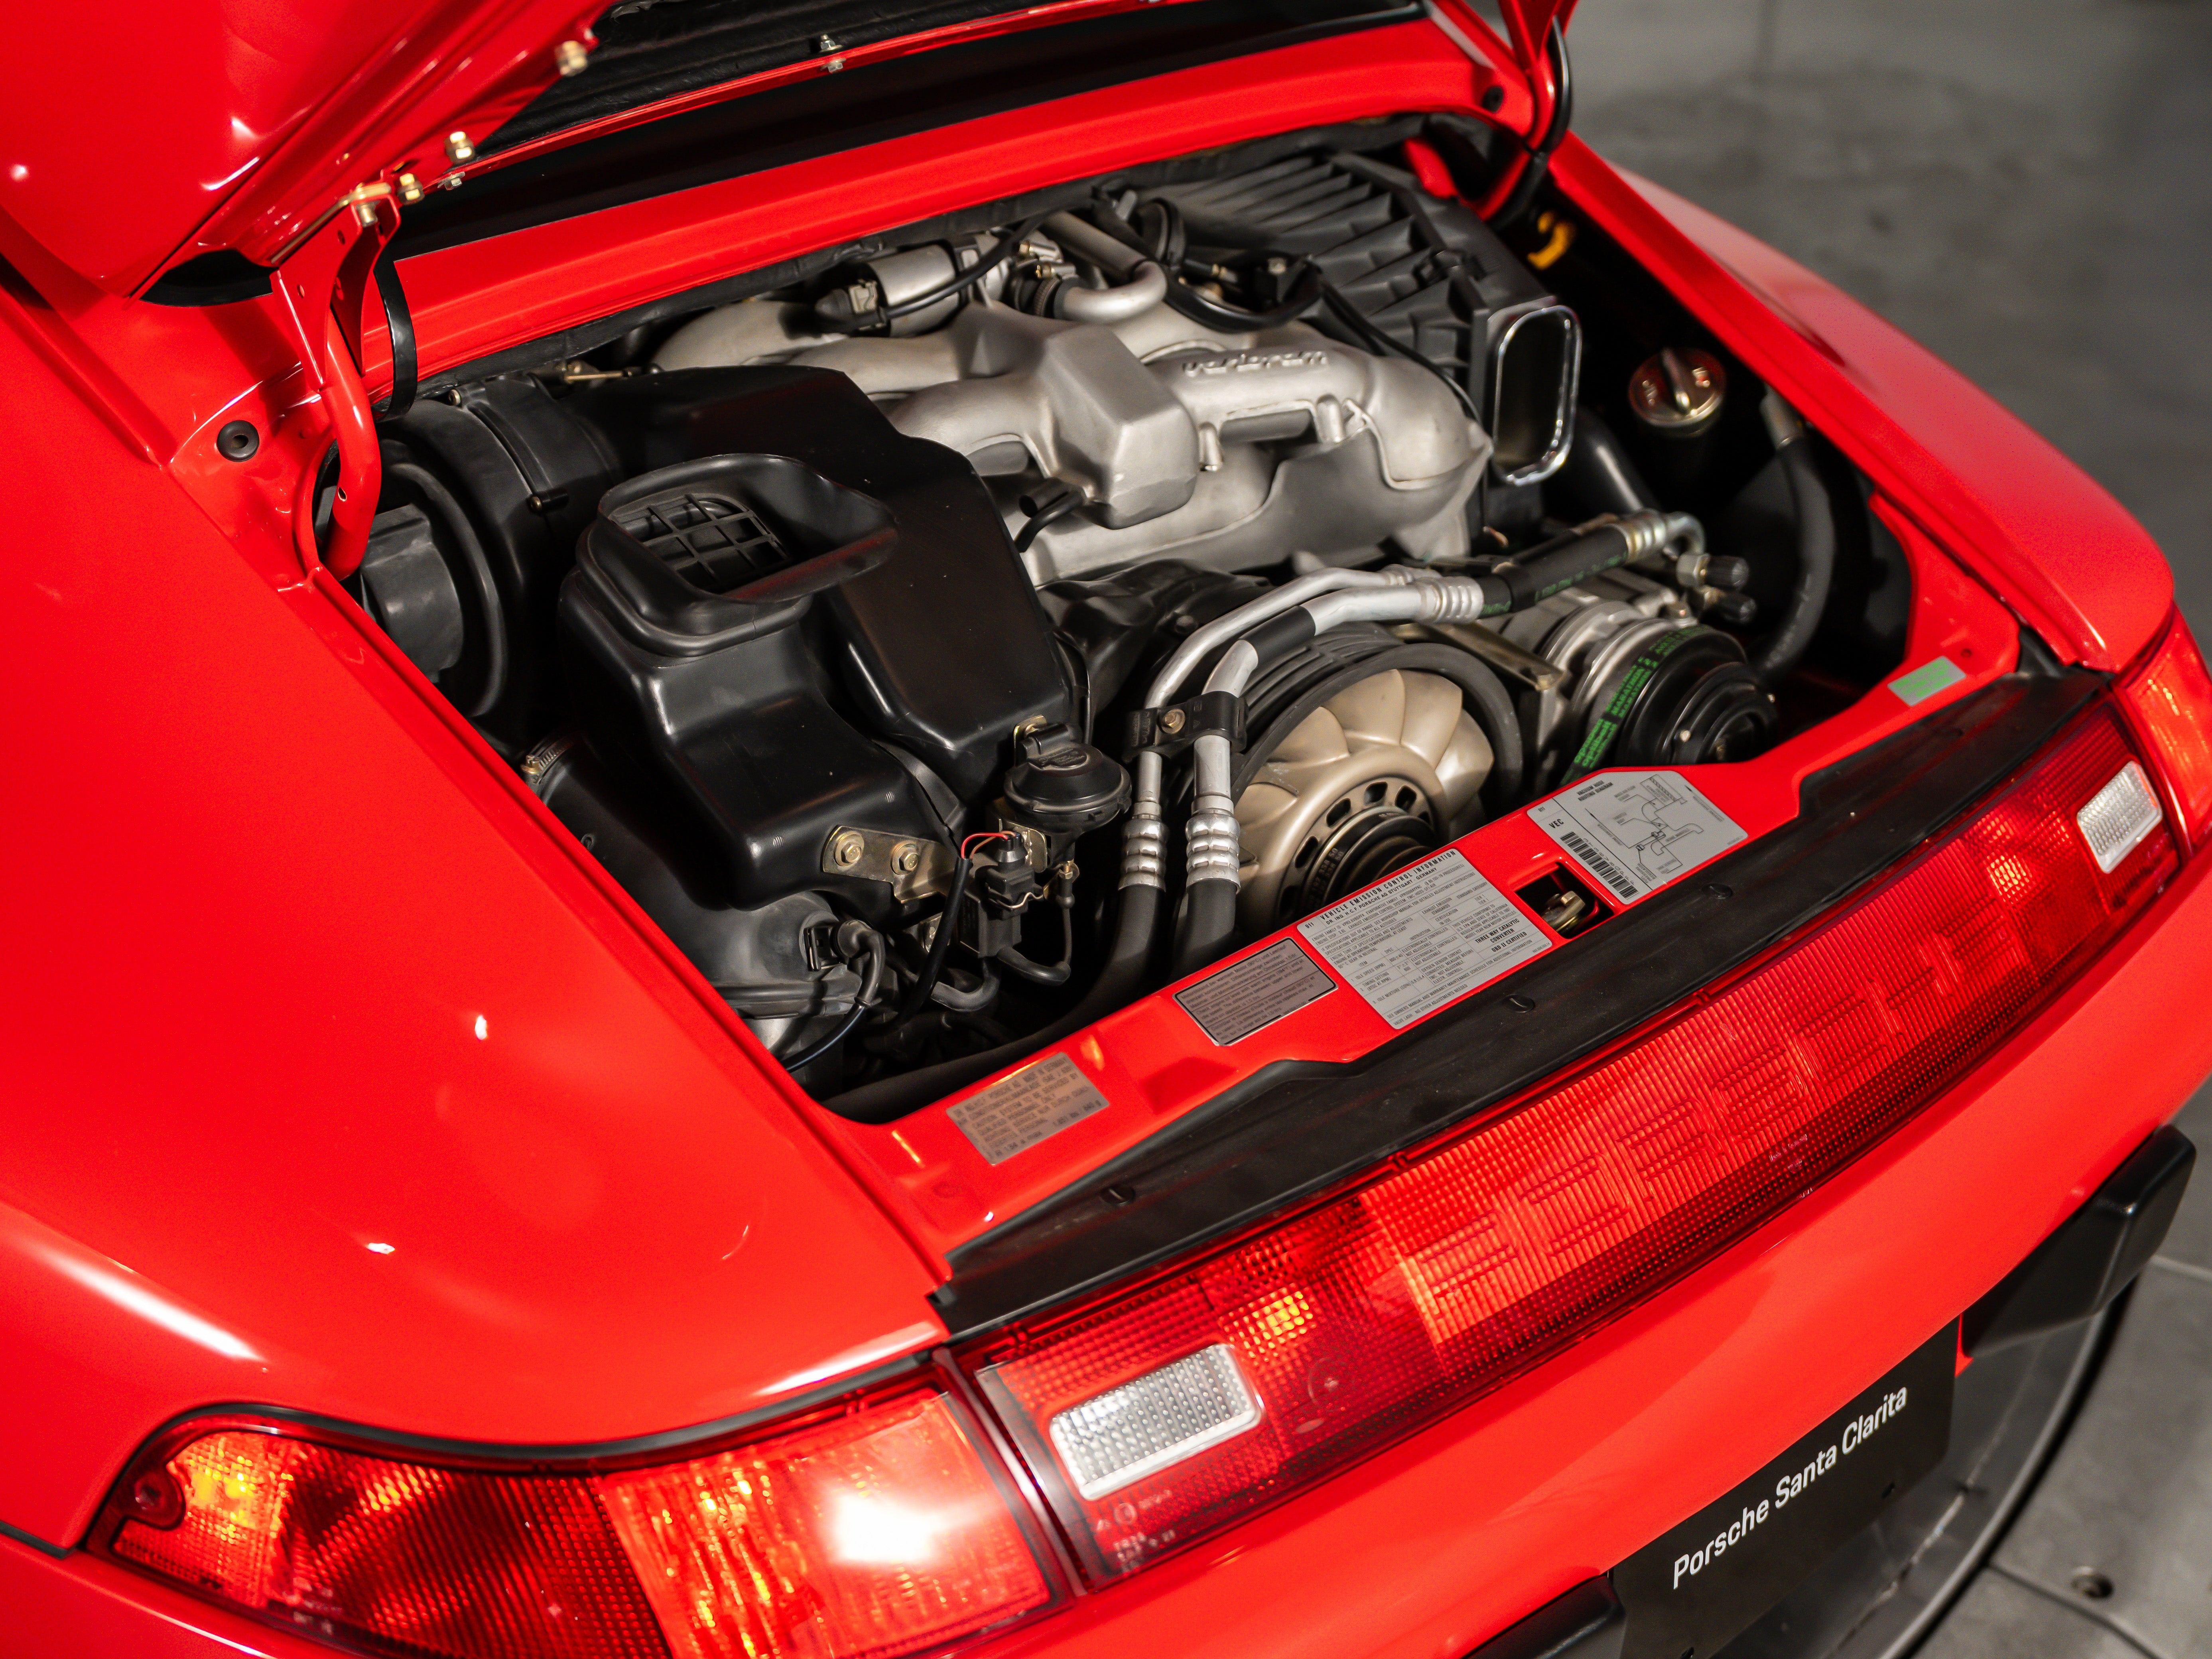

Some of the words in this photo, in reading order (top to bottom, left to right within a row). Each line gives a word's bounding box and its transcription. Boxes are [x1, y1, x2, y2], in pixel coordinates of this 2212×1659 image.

[1576, 785, 1594, 796] VACUUM
[1577, 790, 1596, 801] ROUTING
[1594, 781, 1613, 793] DIAGRAM
[1548, 818, 1565, 829] VEC
[1319, 904, 1349, 920] VEHICLE
[1349, 887, 1383, 906] EMISSION
[1383, 872, 1413, 889] CONTROL
[1412, 851, 1456, 874] INFORMATION
[1357, 896, 1381, 908] PORSCHE
[1387, 879, 1414, 894] STUTTGART
[1415, 867, 1438, 880] GERMANY
[1456, 889, 1473, 899] STANDARD
[1471, 881, 1489, 891] CATEGORY
[1421, 905, 1437, 914] EXHAUST
[1435, 896, 1452, 907] EMISSION
[1431, 903, 1451, 915] STANDARDS
[1489, 903, 1509, 914] CALIFORNIA
[1311, 933, 1325, 942] ENGINE
[1324, 927, 1337, 935] FAMILY
[1365, 902, 1387, 914] EVAPORATIVE
[1324, 935, 1351, 950] SPECIFICATIONS
[1379, 910, 1400, 922] WORKSHOP
[1398, 904, 1413, 912] MANUAL
[1418, 893, 1434, 902] DETAILED
[1432, 882, 1455, 895] ADJUSTMENT
[1434, 908, 1458, 922] CERTIFICATION
[1459, 915, 1474, 924] VEHICLE
[1472, 906, 1491, 917] CONFORMS
[1460, 922, 1482, 935] REGULATIONS
[1481, 913, 1499, 924] APPLICABLE
[1314, 937, 1329, 945] ENGINE
[1347, 920, 1363, 929] EXHAUST
[1361, 912, 1379, 922] EMISSION
[1377, 904, 1394, 914] CONTROL
[1474, 934, 1490, 944] THREE
[1497, 918, 1520, 931] CATALYTIC
[1324, 941, 1351, 956] SPECIFICATIONS
[1349, 931, 1370, 943] APPLICABLE
[1379, 917, 1397, 928] ALTITUDES
[1330, 952, 1343, 961] ENGINE
[1357, 932, 1383, 947] SPECIFICATIONS
[1389, 917, 1413, 931] ADJUSTMENTS
[1408, 928, 1431, 941] INSTRUCTION
[1489, 928, 1515, 943] CONVERTER
[1505, 931, 1527, 944] CERTIFIED
[1401, 937, 1429, 953] ELECTRONICALLY
[1410, 946, 1438, 962] ELECTRONICALLY
[1411, 941, 1432, 953] ADJUSTABLE
[1333, 956, 1347, 965] ENGINE
[1350, 945, 1370, 956] OPERATING
[1420, 950, 1442, 962] ADJUSTABLE
[1420, 963, 1435, 972] OXYGEN
[1434, 956, 1448, 965] SENSOR
[1447, 949, 1462, 958] CONTACT
[1444, 955, 1462, 965] MEASURE
[1460, 948, 1474, 957] BEFORE
[1373, 962, 1386, 970] (RPM)
[1408, 997, 1423, 1007] MANUAL
[1469, 963, 1487, 974] SCHEDULE
[1492, 950, 1512, 962] ADDITIONAL
[1510, 939, 1533, 952] INFORMATION
[1361, 978, 1376, 987] TIMING
[1374, 971, 1389, 980] SETTING
[1384, 987, 1400, 997] MIXTURE
[1430, 991, 1455, 1005] ADJUSTMENTS
[1453, 983, 1468, 993] NEEDED
[1674, 1499, 1769, 1590] Porsche
[1775, 1444, 1838, 1509] Santa
[1842, 1387, 1908, 1455] Clarita
